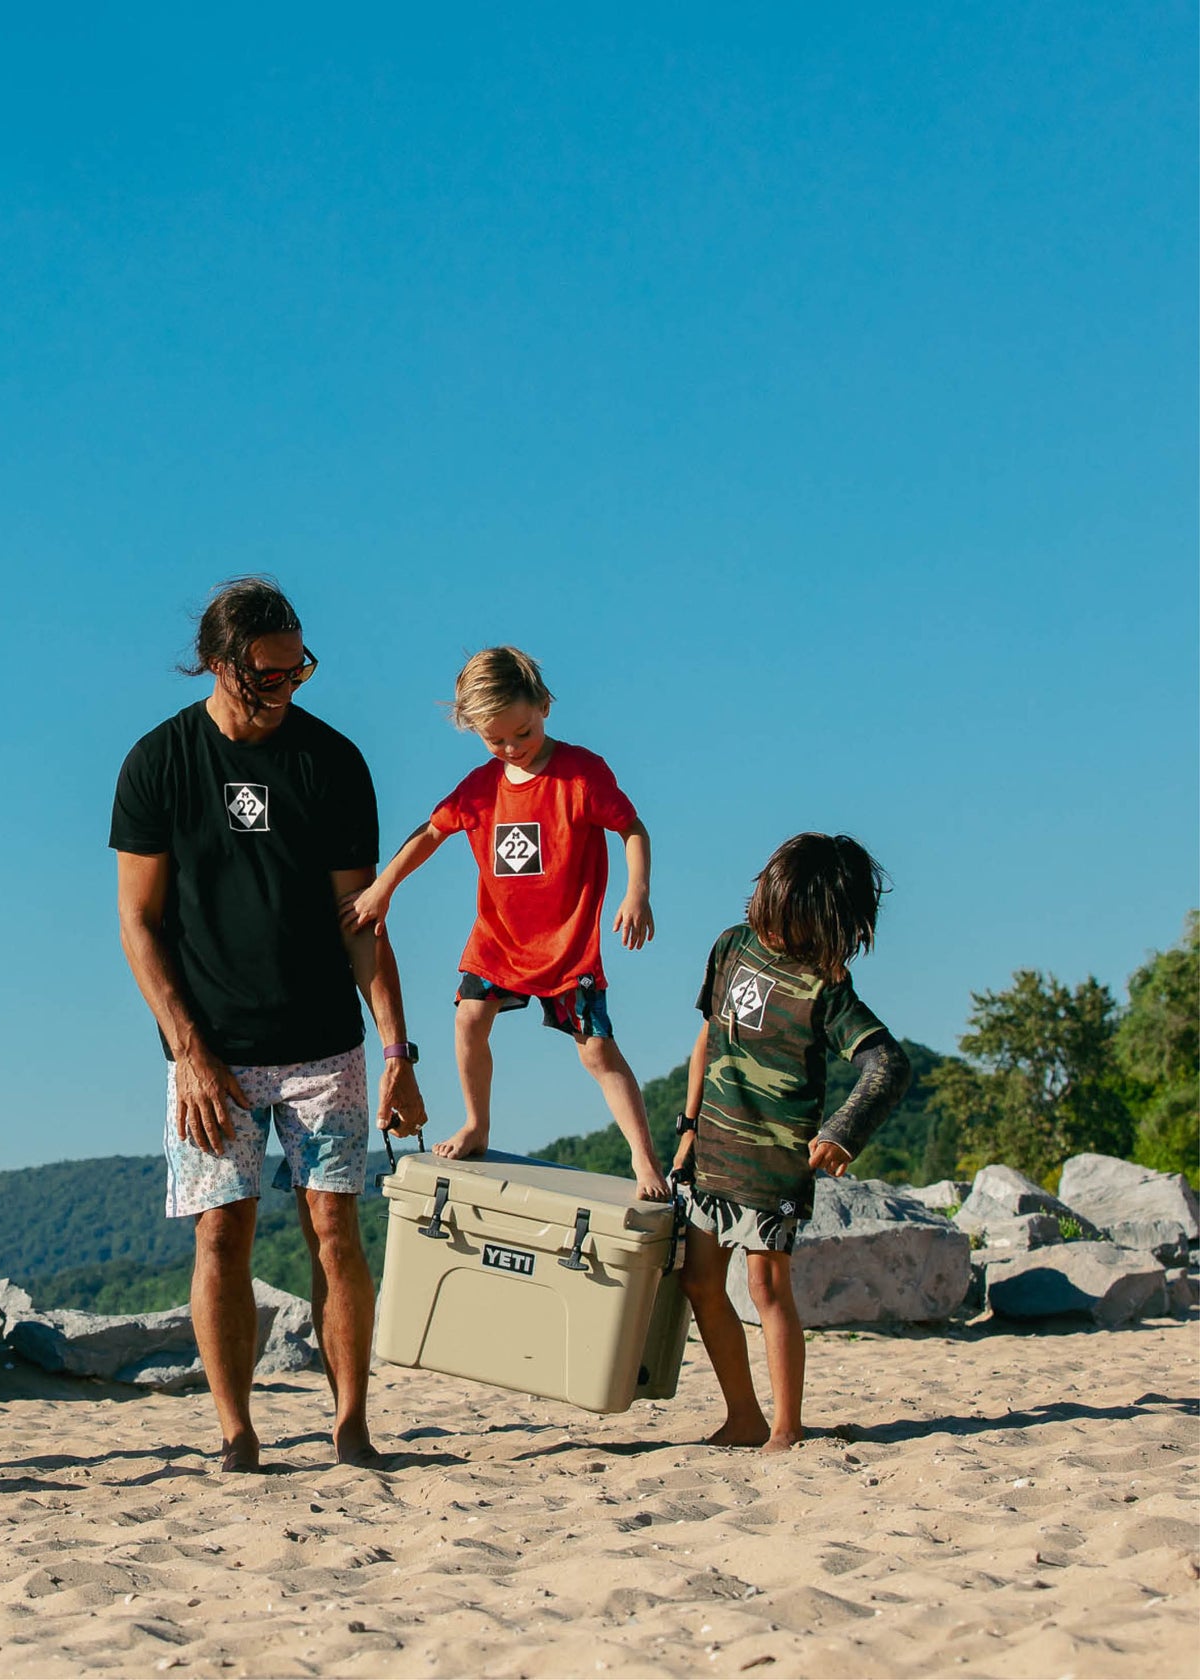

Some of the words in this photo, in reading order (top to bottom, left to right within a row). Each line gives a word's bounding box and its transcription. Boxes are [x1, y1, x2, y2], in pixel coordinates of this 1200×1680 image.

[237, 799, 257, 816] 22
[504, 840, 529, 860] 22
[735, 986, 756, 1010] 22
[486, 1247, 532, 1272] YETI
